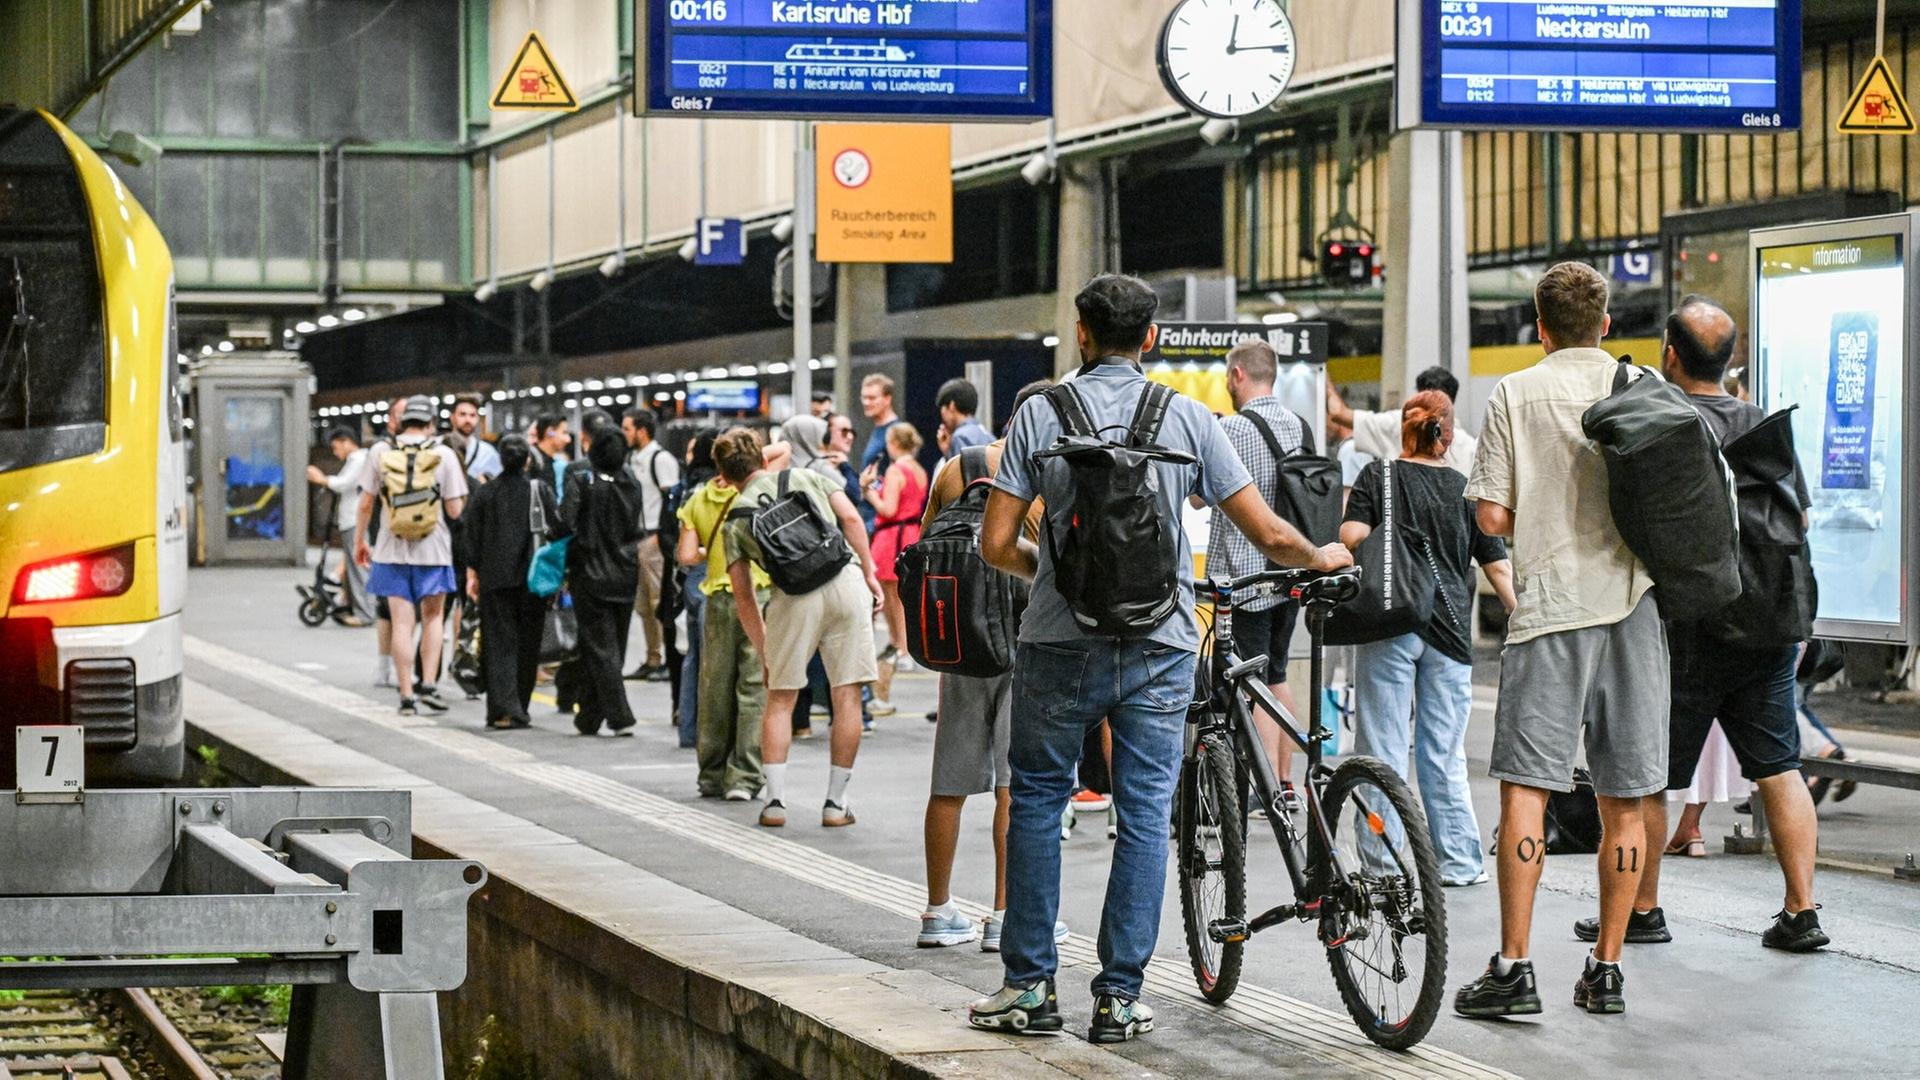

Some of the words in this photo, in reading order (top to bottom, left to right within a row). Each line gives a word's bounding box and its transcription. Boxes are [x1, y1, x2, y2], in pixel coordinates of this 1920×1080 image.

[670, 0, 727, 20] 00:16
[772, 1, 871, 24] Karlsruhe
[877, 4, 912, 25] Hbf
[1537, 4, 1598, 17] Ludwigsburg
[1664, 6, 1709, 18] Heilbronn
[1711, 7, 1729, 18] Hbf
[1441, 15, 1493, 37] 00:31
[1536, 16, 1650, 39] Neckarsulm
[804, 66, 847, 77] Ankunft
[849, 68, 868, 78] von
[870, 67, 921, 79] Karlsruhe
[923, 68, 942, 79] Hbf
[804, 79, 865, 91] Neckarsulm
[872, 80, 887, 91] via
[890, 81, 954, 94] Ludwigsburg
[1019, 82, 1028, 94] F
[1669, 81, 1730, 94] Ludwigsburg
[671, 96, 703, 110] Gleis
[704, 97, 713, 110] 7
[1579, 92, 1628, 104] Pforzheim
[1629, 92, 1647, 105] Hbf
[1653, 94, 1669, 105] via
[1671, 93, 1732, 107] Ludwigsburg
[1742, 112, 1771, 126] Gleis
[1772, 114, 1781, 126] 8
[831, 209, 937, 222] Raucherbereich
[701, 219, 725, 256] F
[842, 228, 893, 242] Smoking
[900, 229, 927, 240] Area
[1622, 240, 1649, 276] G
[1813, 243, 1862, 267] Information
[1384, 476, 1392, 499] NEVER
[1384, 499, 1392, 509] DO
[1384, 515, 1392, 532] NOW
[1384, 531, 1392, 541] OR
[1384, 541, 1392, 563] NEVER
[1384, 563, 1392, 573] DO
[1384, 573, 1392, 581] IT
[1384, 581, 1392, 598] NOW
[41, 736, 59, 777] 7
[1615, 846, 1638, 873] 11
